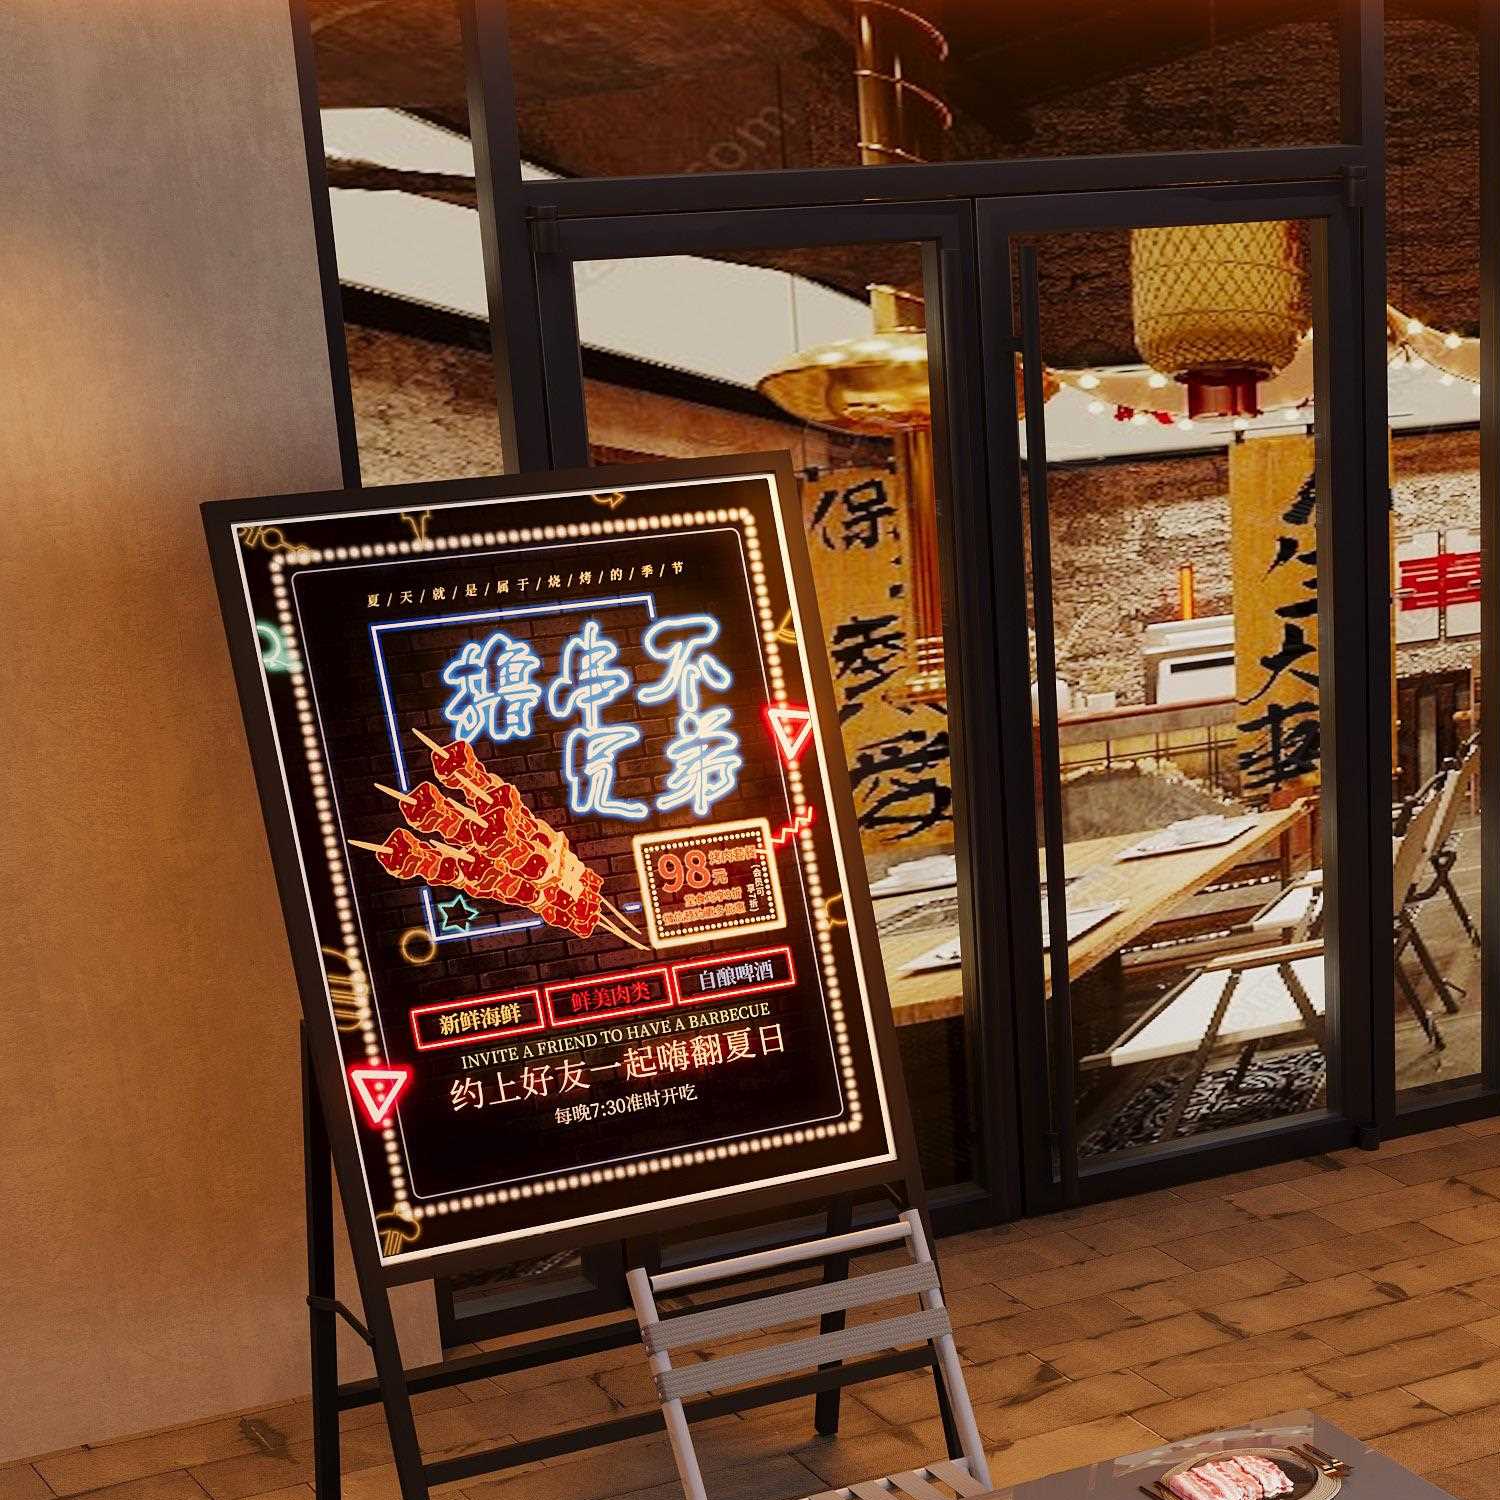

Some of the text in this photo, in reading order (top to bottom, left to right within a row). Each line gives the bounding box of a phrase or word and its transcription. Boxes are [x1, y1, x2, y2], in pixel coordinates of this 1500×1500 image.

[657, 850, 711, 893] 98
[438, 959, 775, 1036] 新鲜海鲜 鲜美肉类 自酿啤酒
[449, 1022, 785, 1112] 约上好友一起嗨翻夏日
[461, 1003, 771, 1070] INVITE A FRIEND TO HAVE A BARBECUE
[554, 1083, 699, 1126] 每晚7:30准时开吃
